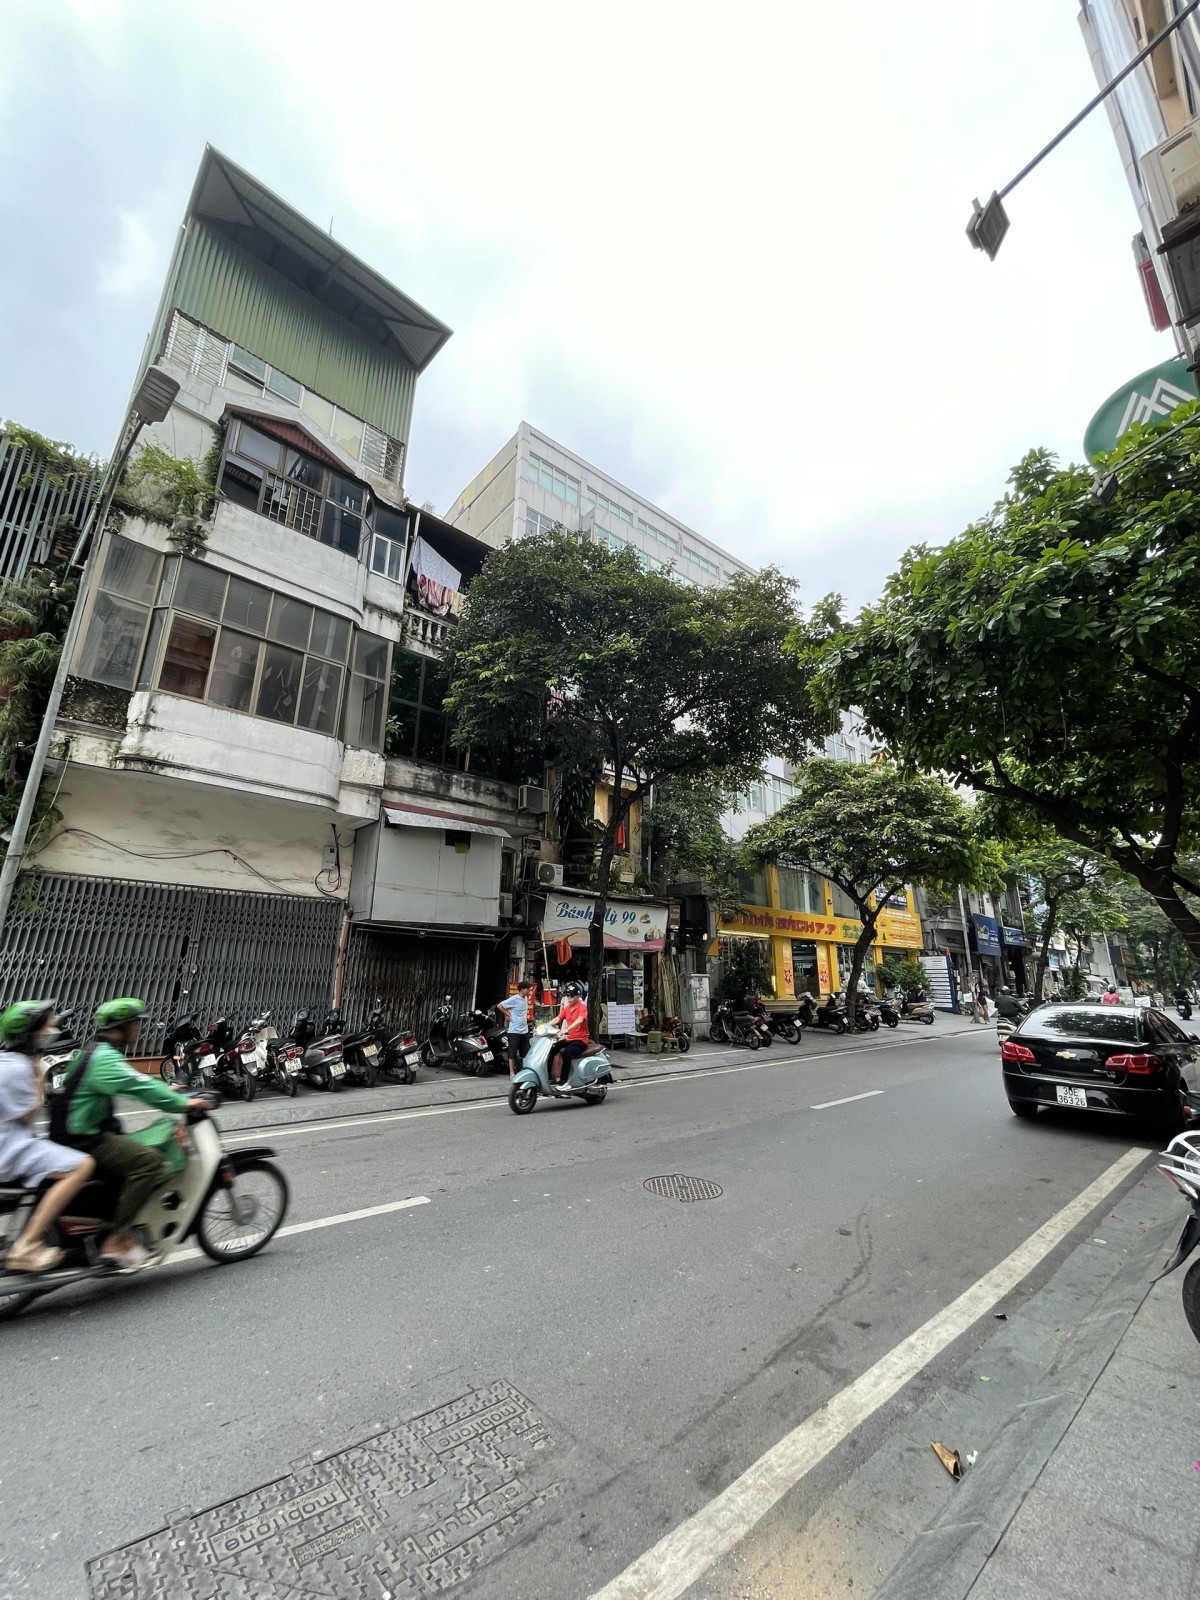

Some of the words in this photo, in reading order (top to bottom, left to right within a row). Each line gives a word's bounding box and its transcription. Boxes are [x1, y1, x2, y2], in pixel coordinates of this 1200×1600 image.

[556, 901, 593, 921] Bánh
[622, 911, 636, 924] 99
[436, 1404, 519, 1450] mobifone
[223, 1491, 339, 1555] mobifone
